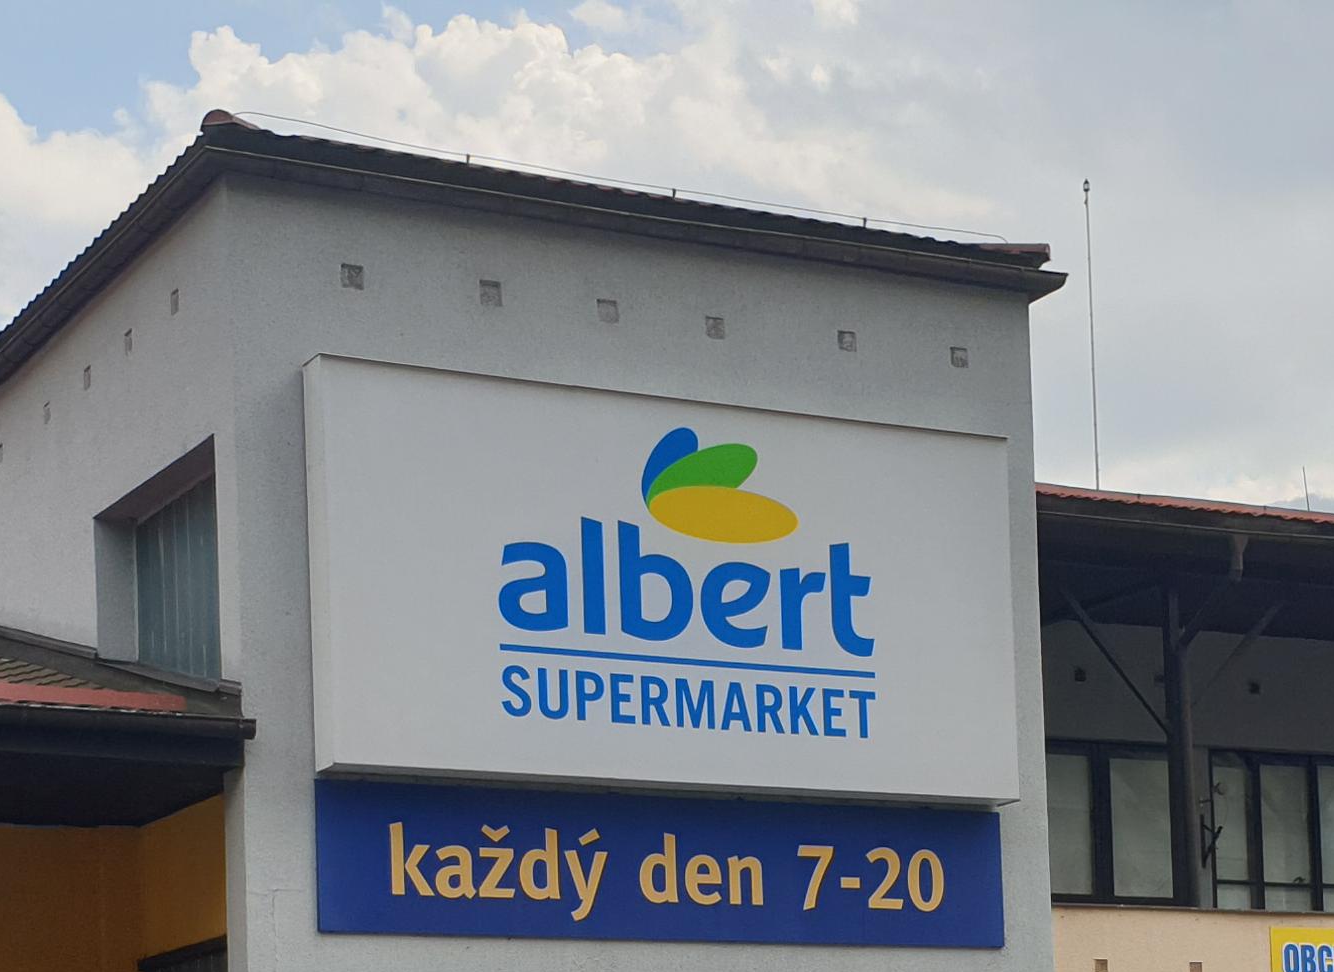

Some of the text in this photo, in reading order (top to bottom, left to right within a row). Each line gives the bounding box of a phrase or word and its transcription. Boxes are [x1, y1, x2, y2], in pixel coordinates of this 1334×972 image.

[498, 516, 875, 657] albert
[501, 664, 876, 739] SUPERMARKET
[389, 821, 945, 922] každý den 7-20
